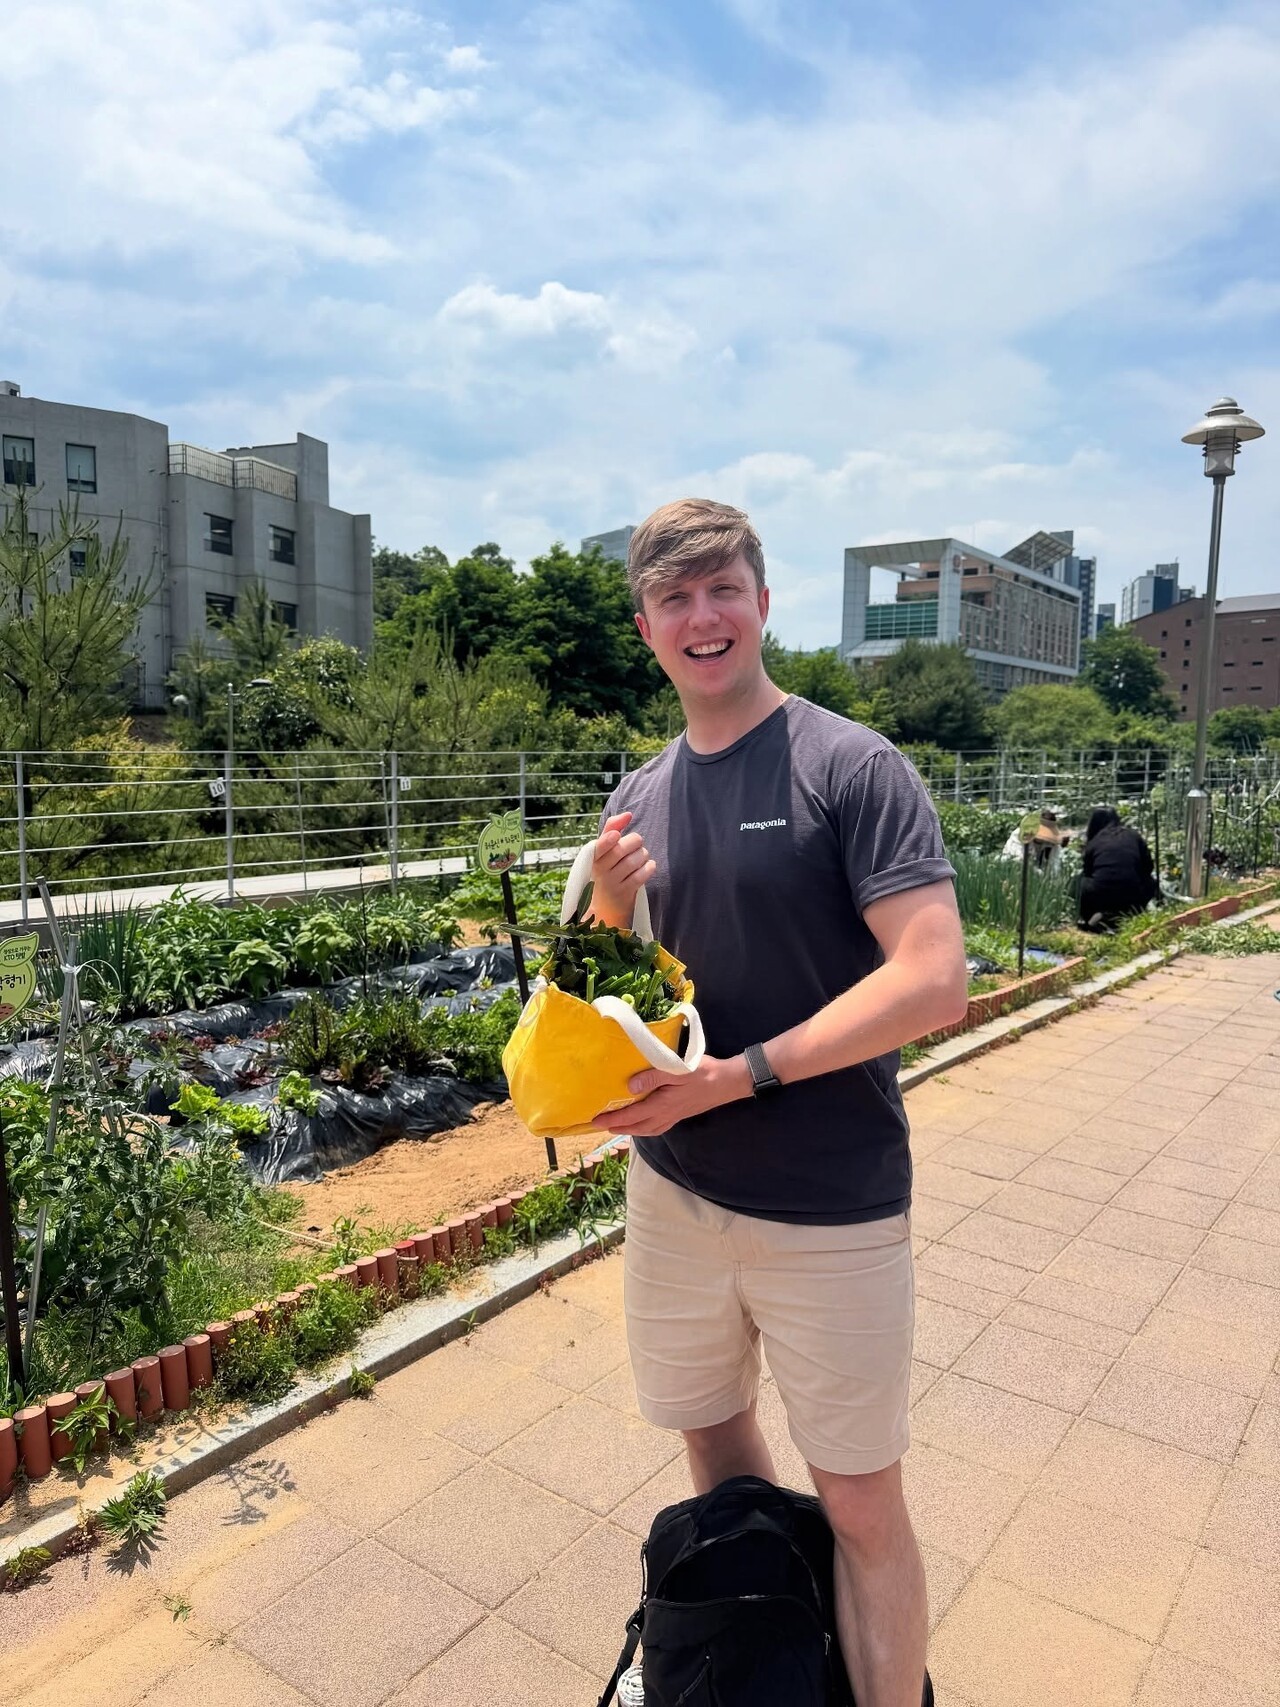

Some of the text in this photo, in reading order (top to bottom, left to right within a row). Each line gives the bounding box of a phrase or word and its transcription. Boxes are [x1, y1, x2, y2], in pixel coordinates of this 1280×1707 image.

[212, 783, 223, 795] 10
[740, 818, 787, 831] patagonia
[0, 974, 26, 991] 형기
